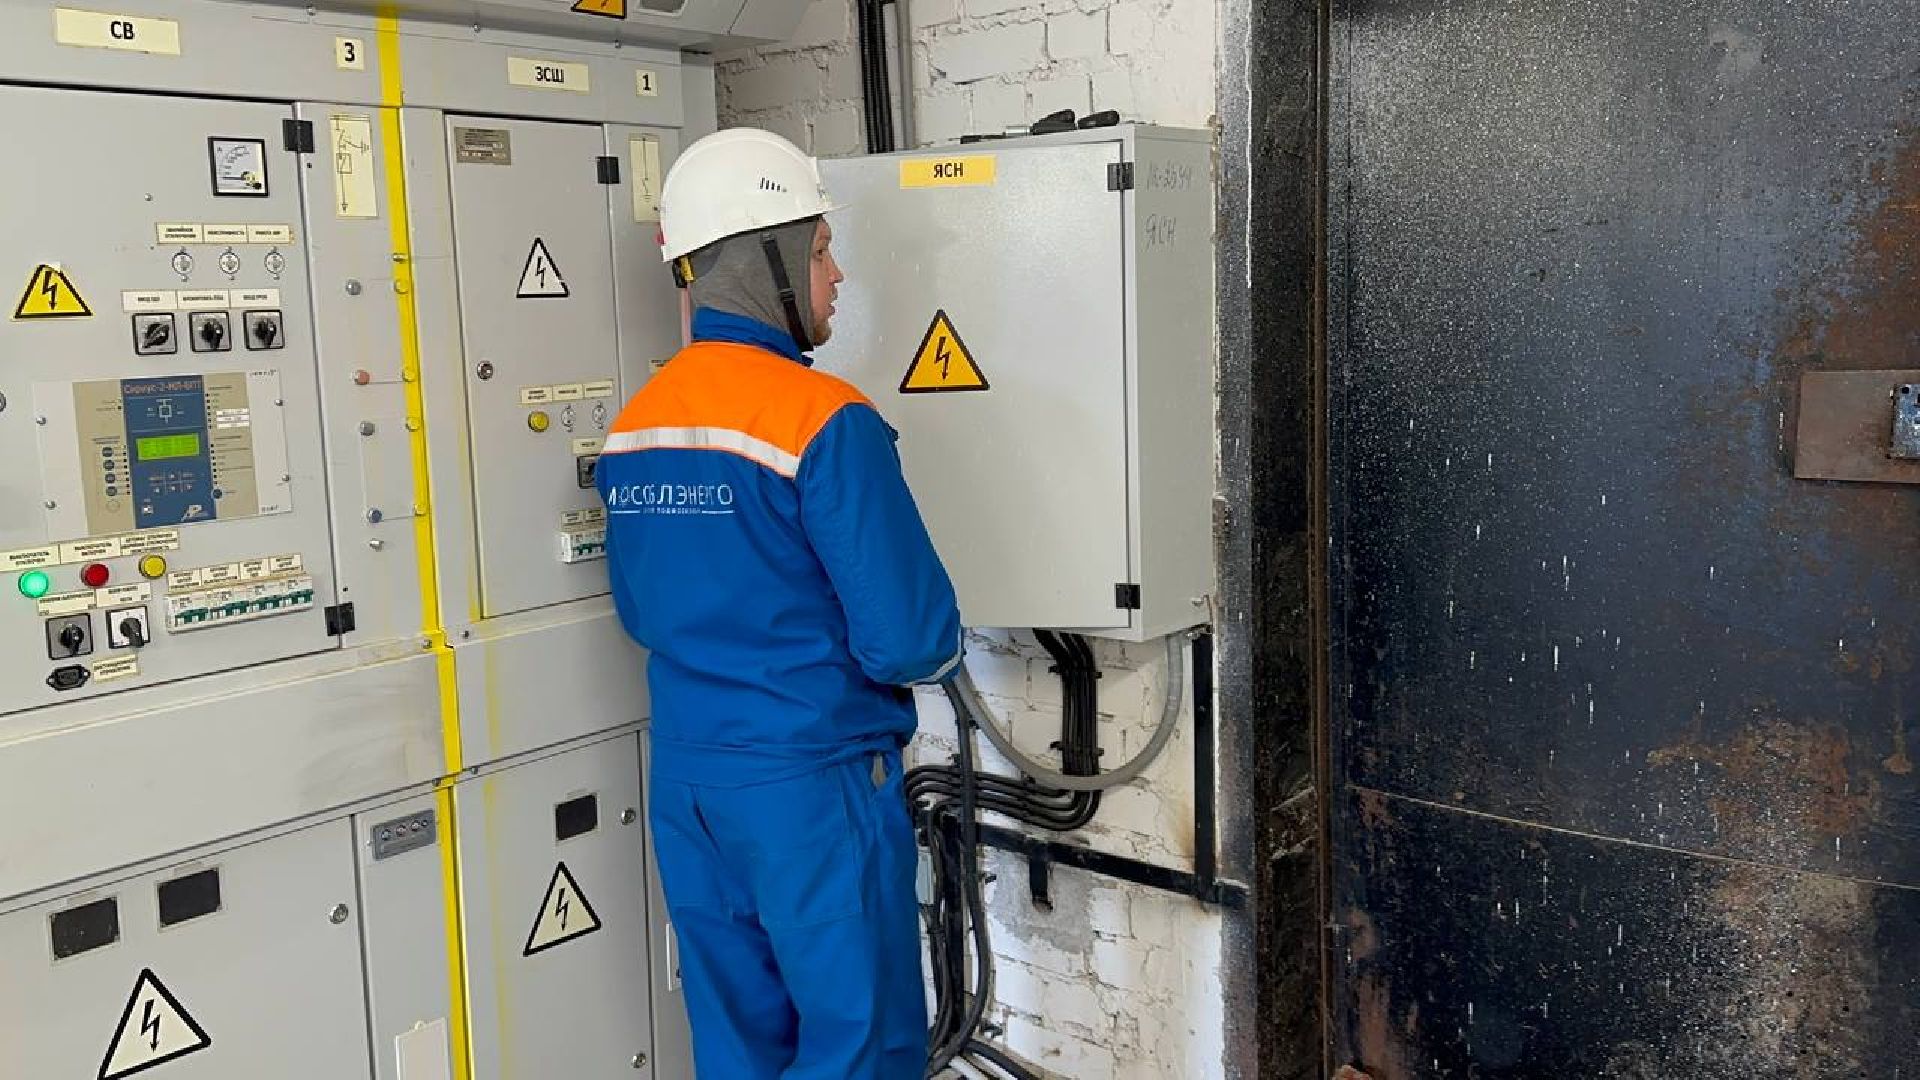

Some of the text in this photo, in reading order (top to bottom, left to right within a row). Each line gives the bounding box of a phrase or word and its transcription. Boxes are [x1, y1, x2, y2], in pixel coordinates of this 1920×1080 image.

[110, 20, 135, 40] СВ
[344, 42, 355, 62] 3
[642, 73, 652, 91] 1
[933, 162, 964, 179] ЯСН
